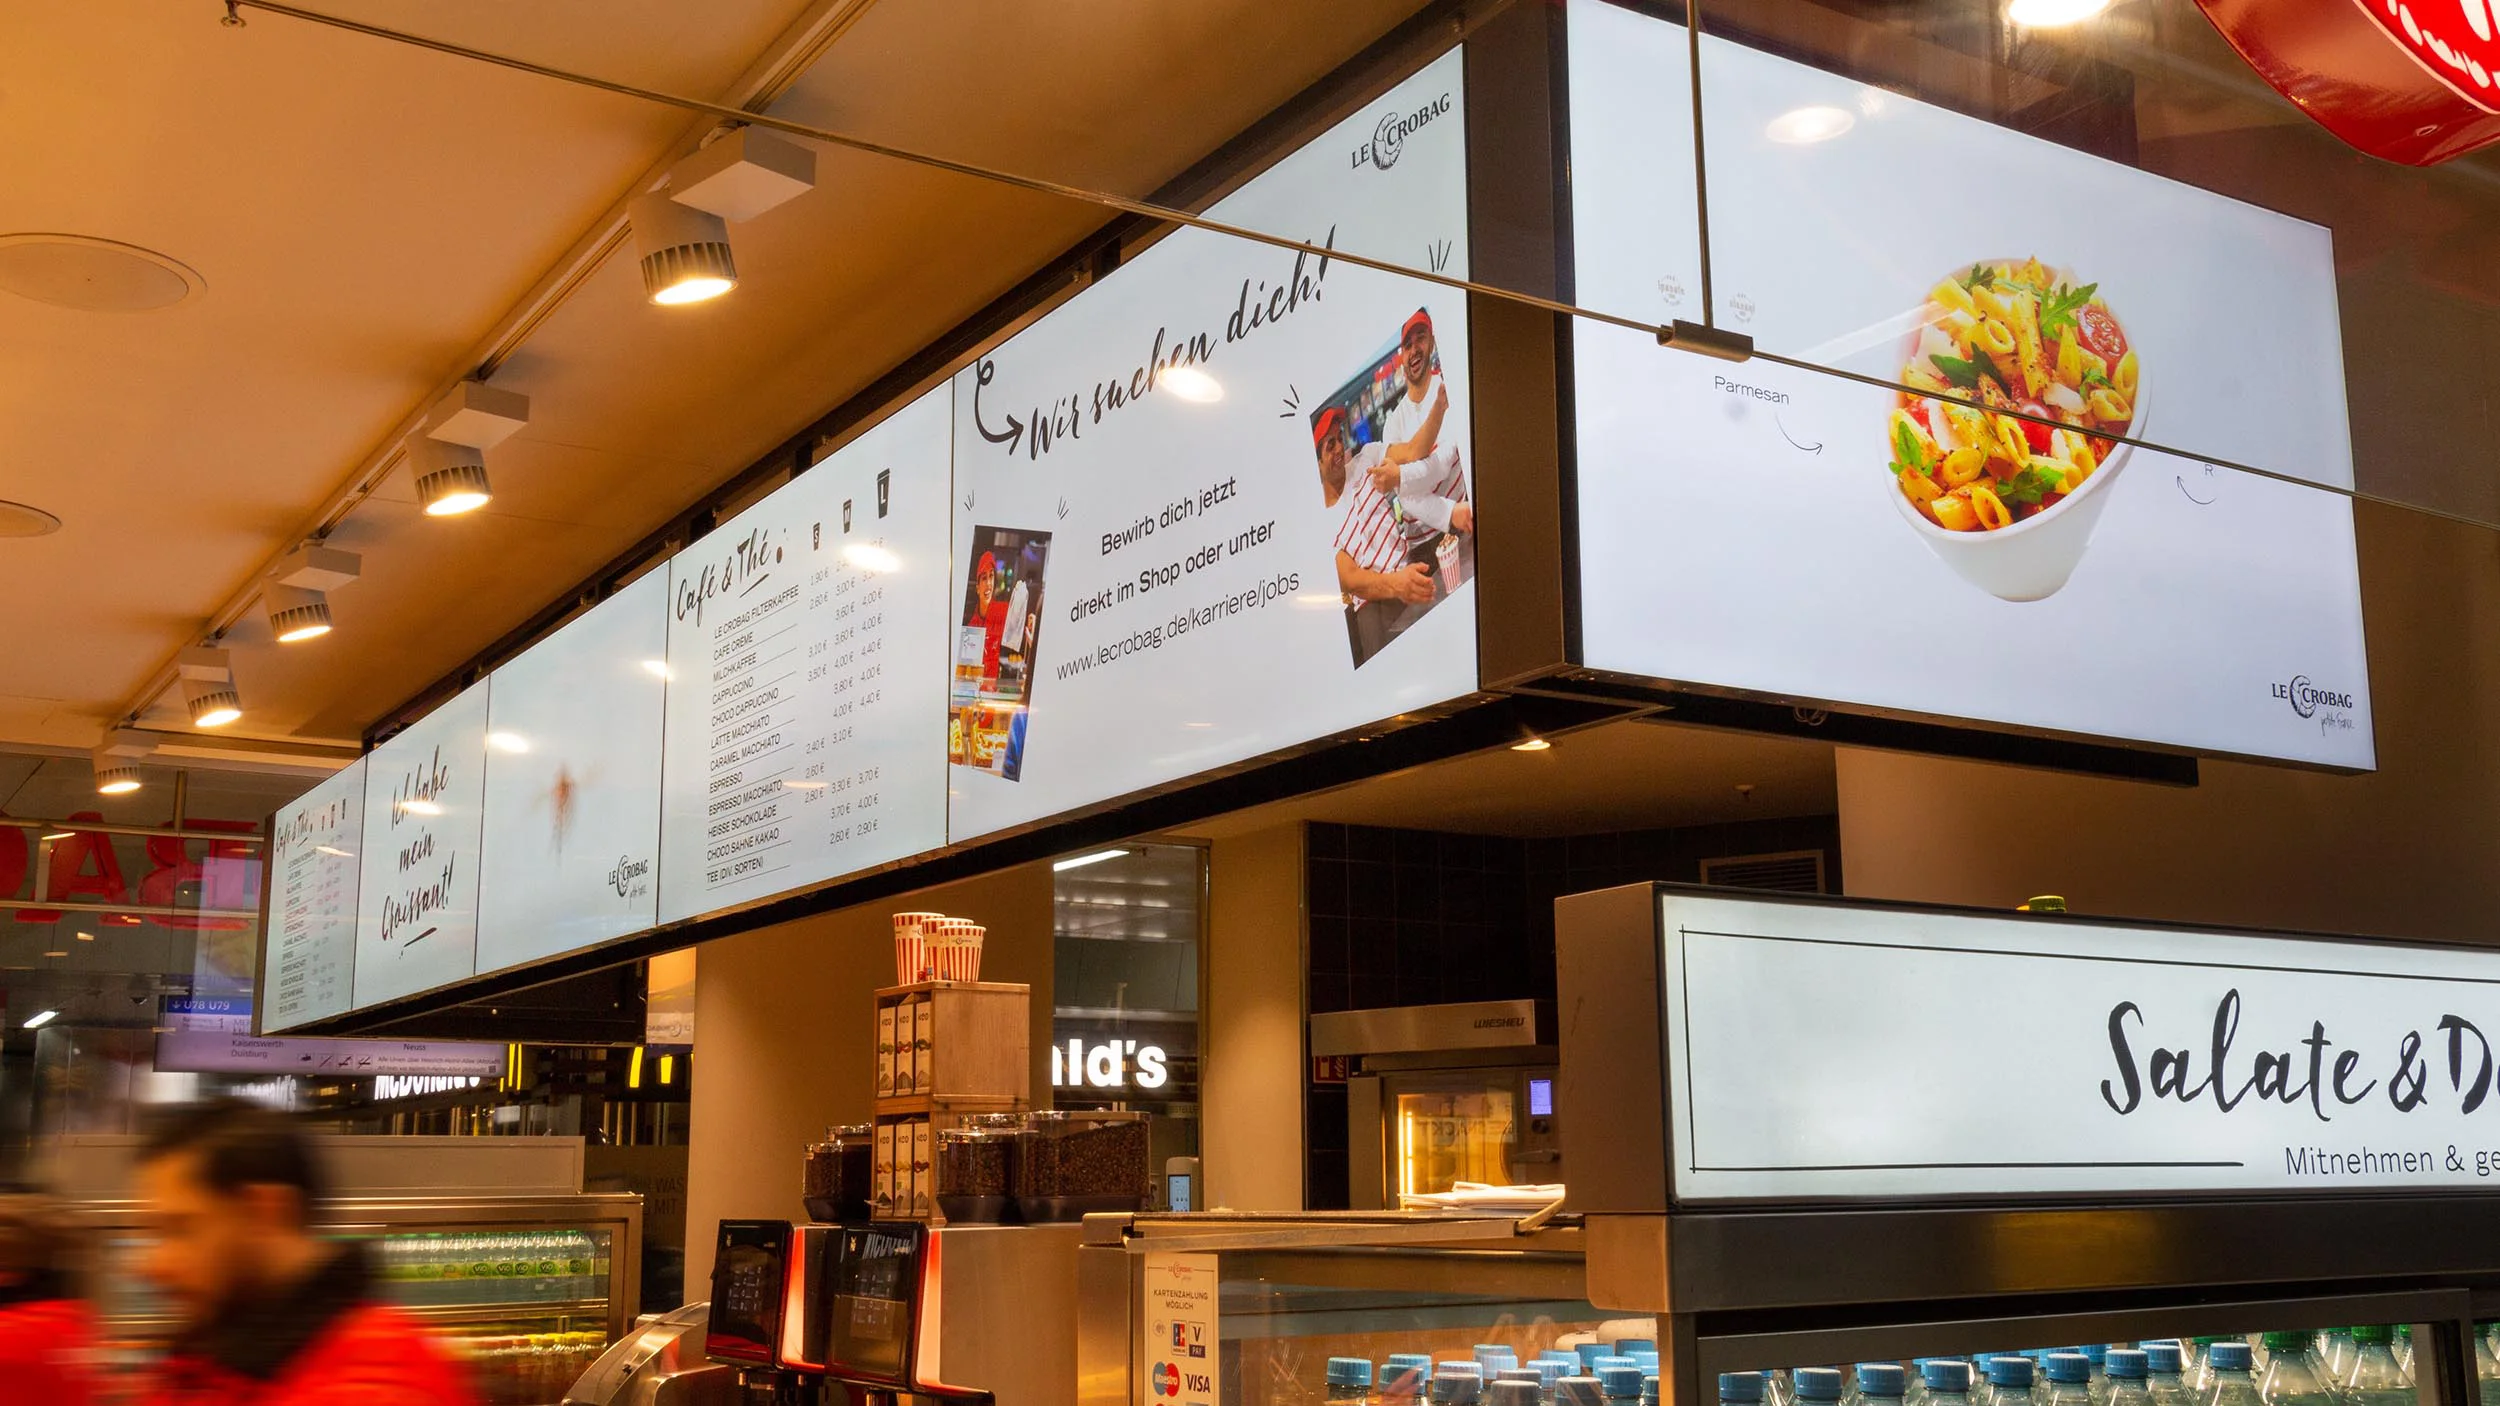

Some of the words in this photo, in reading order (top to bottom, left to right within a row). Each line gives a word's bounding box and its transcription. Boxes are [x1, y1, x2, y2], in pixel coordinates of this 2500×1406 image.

[1352, 143, 1370, 169] LE
[1387, 92, 1450, 146] CROBAG
[1030, 394, 1080, 460] Wir
[1090, 327, 1217, 424] suchen
[1226, 224, 1336, 343] dich!
[1714, 375, 1790, 404] Parmesan
[1101, 516, 1155, 556] Bewirb
[1160, 497, 1193, 529] dich
[1198, 476, 1237, 516] jetzt
[677, 564, 718, 628] Café
[722, 556, 733, 592] &
[737, 527, 772, 584] Thé
[1071, 588, 1112, 622] direkt
[1117, 582, 1134, 602] im
[1140, 562, 1180, 593] Shop
[1185, 543, 1223, 574] oder
[1228, 520, 1275, 555] unter
[1056, 572, 1300, 680] www.lecrobag.de/karriere/jobs
[713, 652, 757, 681] MILCHKAFFEE
[713, 676, 754, 704] CAPPUCCINO
[735, 687, 779, 716] CAPPUCCINO
[2272, 683, 2288, 699] LE
[2302, 687, 2353, 709] CROBAG
[711, 731, 731, 749] LATTE
[731, 714, 770, 739] MACCHIATO
[710, 751, 740, 771] CARAMEL
[741, 733, 781, 758] MACCHIATO
[391, 772, 411, 830] Ich
[414, 744, 450, 803] habe
[709, 771, 743, 794] ESPRESSO
[709, 794, 742, 816] ESPRESSO
[743, 779, 783, 804] MACCHIATO
[708, 821, 730, 838] HEISSE
[731, 804, 777, 830] SCHOKOLADE
[400, 826, 436, 873] mein
[707, 844, 730, 861] CHOCO
[731, 836, 754, 853] SAHNE
[755, 827, 780, 845] KAKAO
[608, 870, 616, 886] LE
[623, 859, 648, 881] CROBAG
[707, 869, 719, 883] TEE
[381, 850, 455, 941] Croissant!
[184, 1000, 205, 1011] U78
[208, 1000, 230, 1012] U79
[1474, 1017, 1526, 1029] WIESHEU
[403, 1043, 427, 1051] Neuss
[2100, 988, 2378, 1122] Salate
[2388, 1030, 2429, 1114] &
[2436, 1013, 2500, 1115] D
[2285, 1146, 2434, 1175] Mitnehmen
[2445, 1144, 2465, 1172] &
[1153, 1289, 1208, 1300] KARTENZAHLUNG
[1165, 1300, 1194, 1310] MÖGLICH
[1185, 1373, 1210, 1393] VISA
